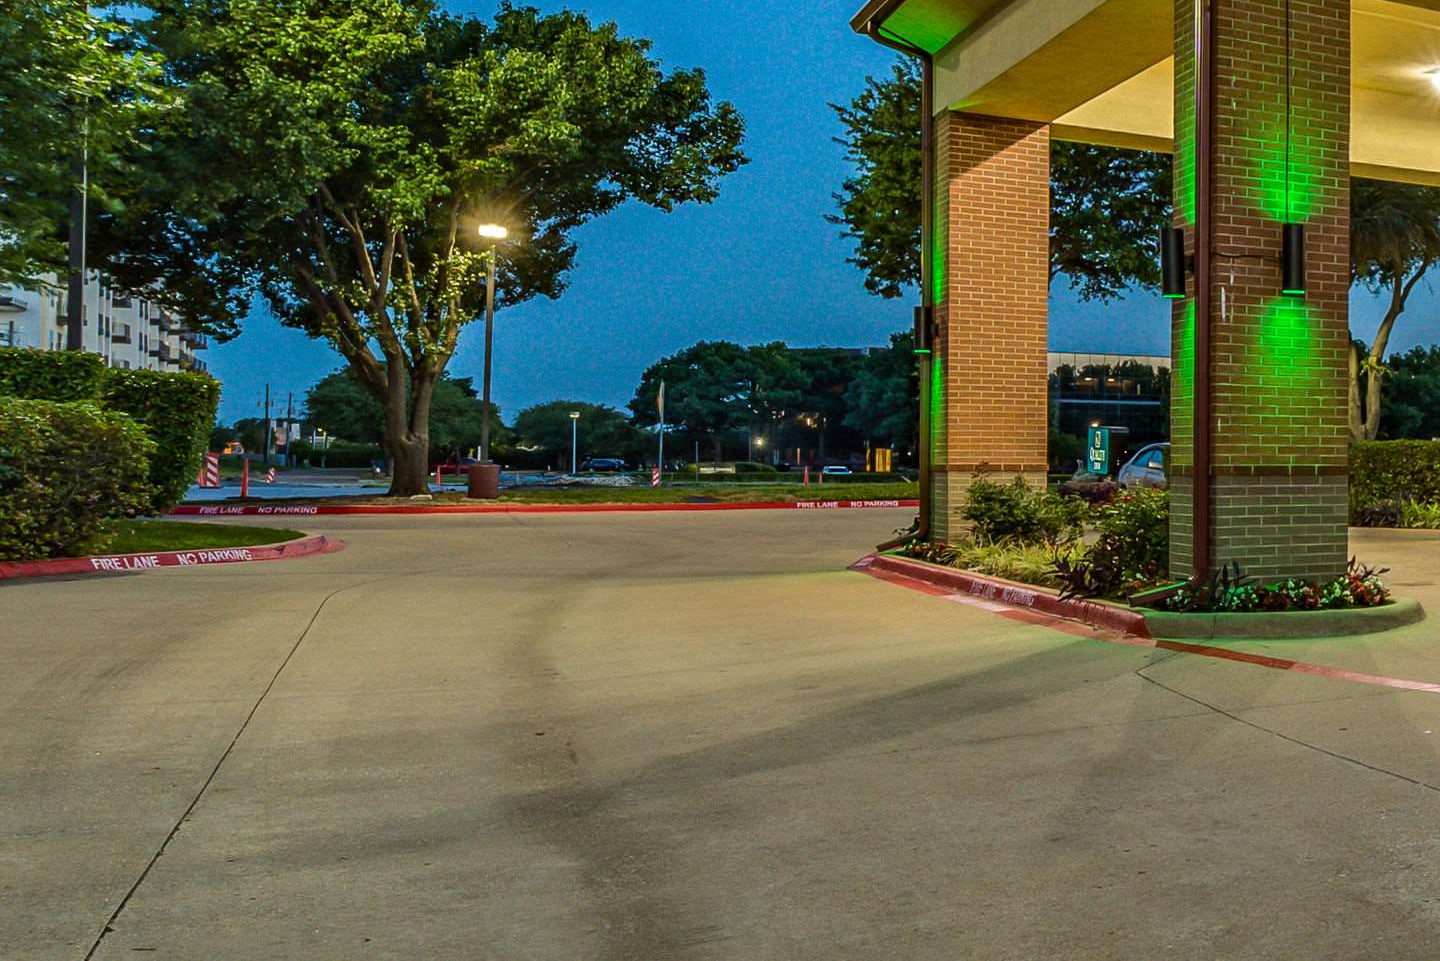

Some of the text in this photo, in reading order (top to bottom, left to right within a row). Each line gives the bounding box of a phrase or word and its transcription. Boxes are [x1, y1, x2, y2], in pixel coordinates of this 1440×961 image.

[219, 506, 244, 514] LANE
[257, 506, 273, 514] NO
[273, 505, 318, 514] PARKING
[91, 549, 253, 570] FIRE LANE NO PARKING
